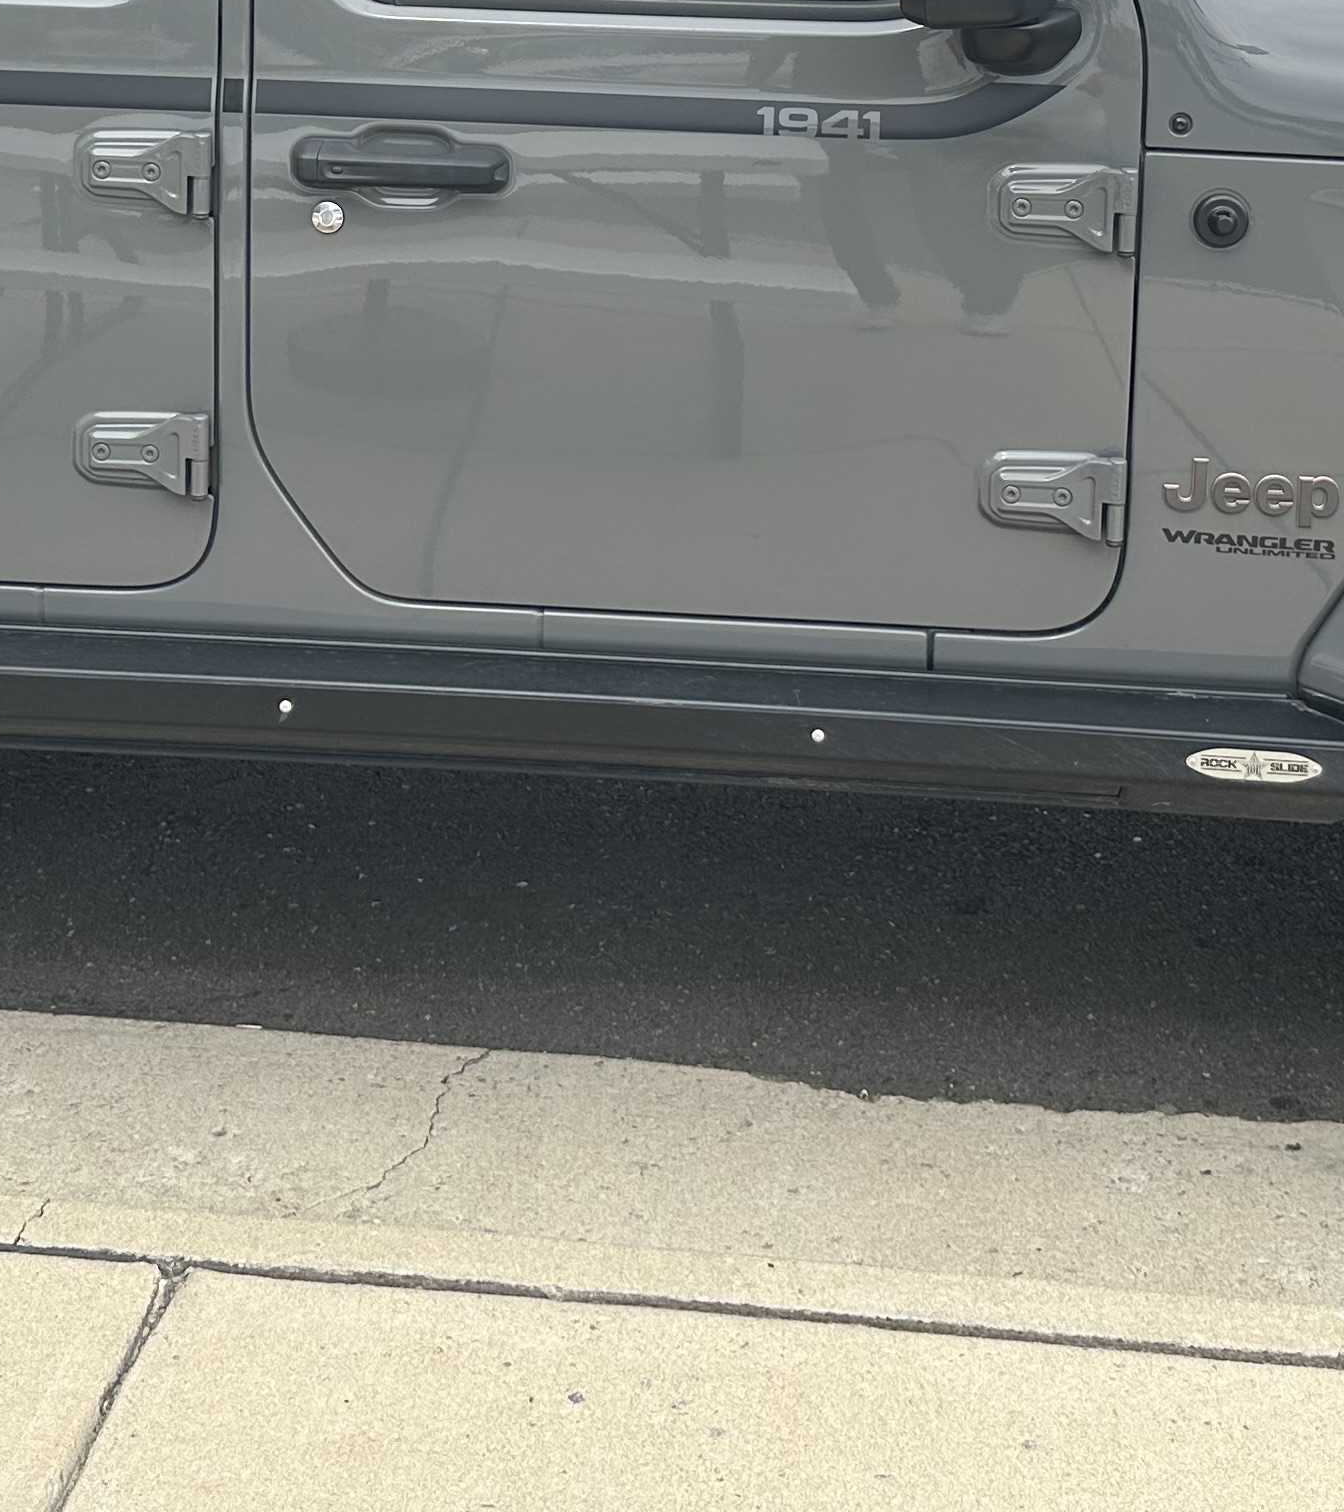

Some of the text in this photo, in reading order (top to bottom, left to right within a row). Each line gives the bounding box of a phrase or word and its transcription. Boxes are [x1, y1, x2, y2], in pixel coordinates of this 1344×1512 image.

[756, 106, 882, 140] 1941
[1161, 456, 1340, 529] Jeep
[1161, 527, 1336, 553] WRANGLER
[1216, 546, 1336, 560] UNLIMITED
[1200, 757, 1238, 769] ROCK
[1269, 762, 1309, 774] SLIDE
